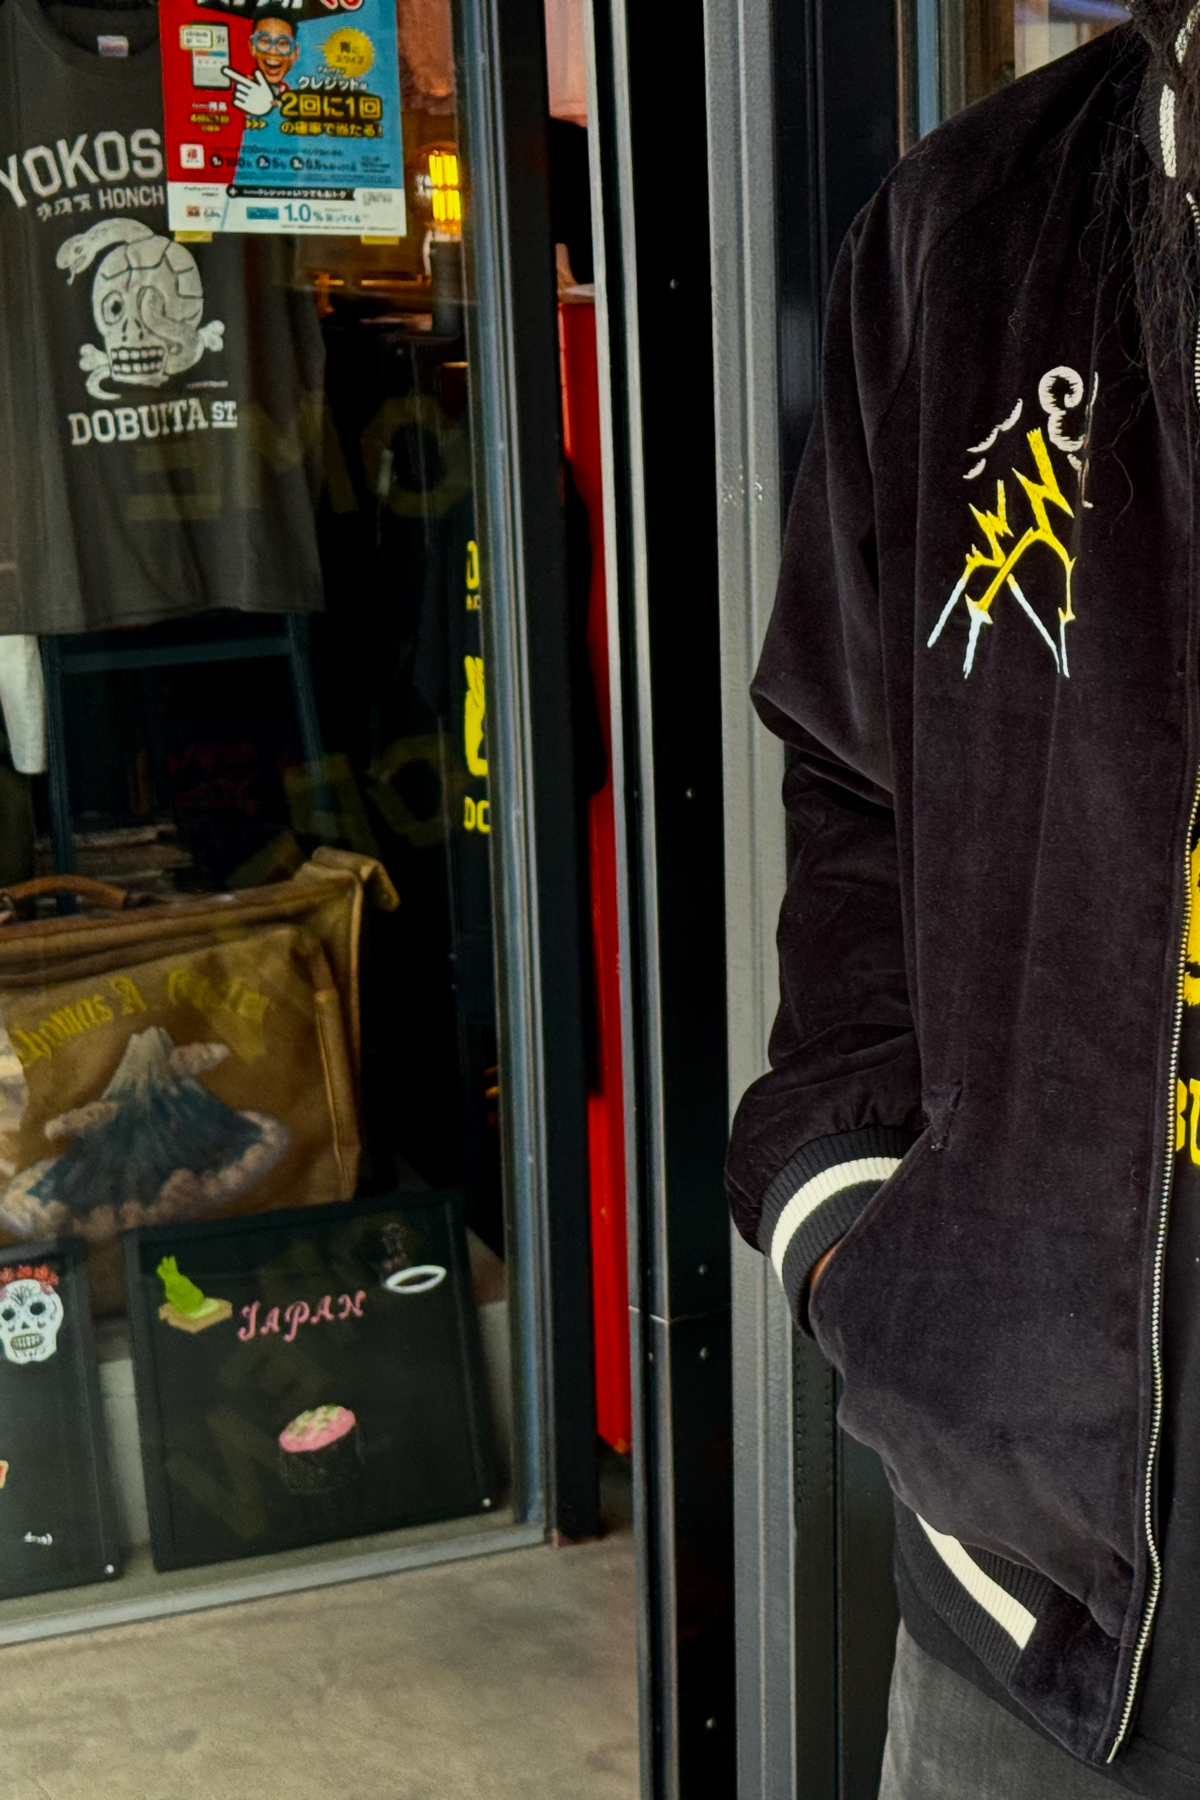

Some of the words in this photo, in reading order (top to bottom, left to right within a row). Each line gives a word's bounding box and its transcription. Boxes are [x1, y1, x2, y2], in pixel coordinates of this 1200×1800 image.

[281, 92, 381, 119] 2回に1回
[0, 129, 163, 208] YOKOS
[98, 185, 165, 210] HONCH
[68, 397, 209, 446] DOBUITA
[238, 1290, 367, 1342] JAPAN
